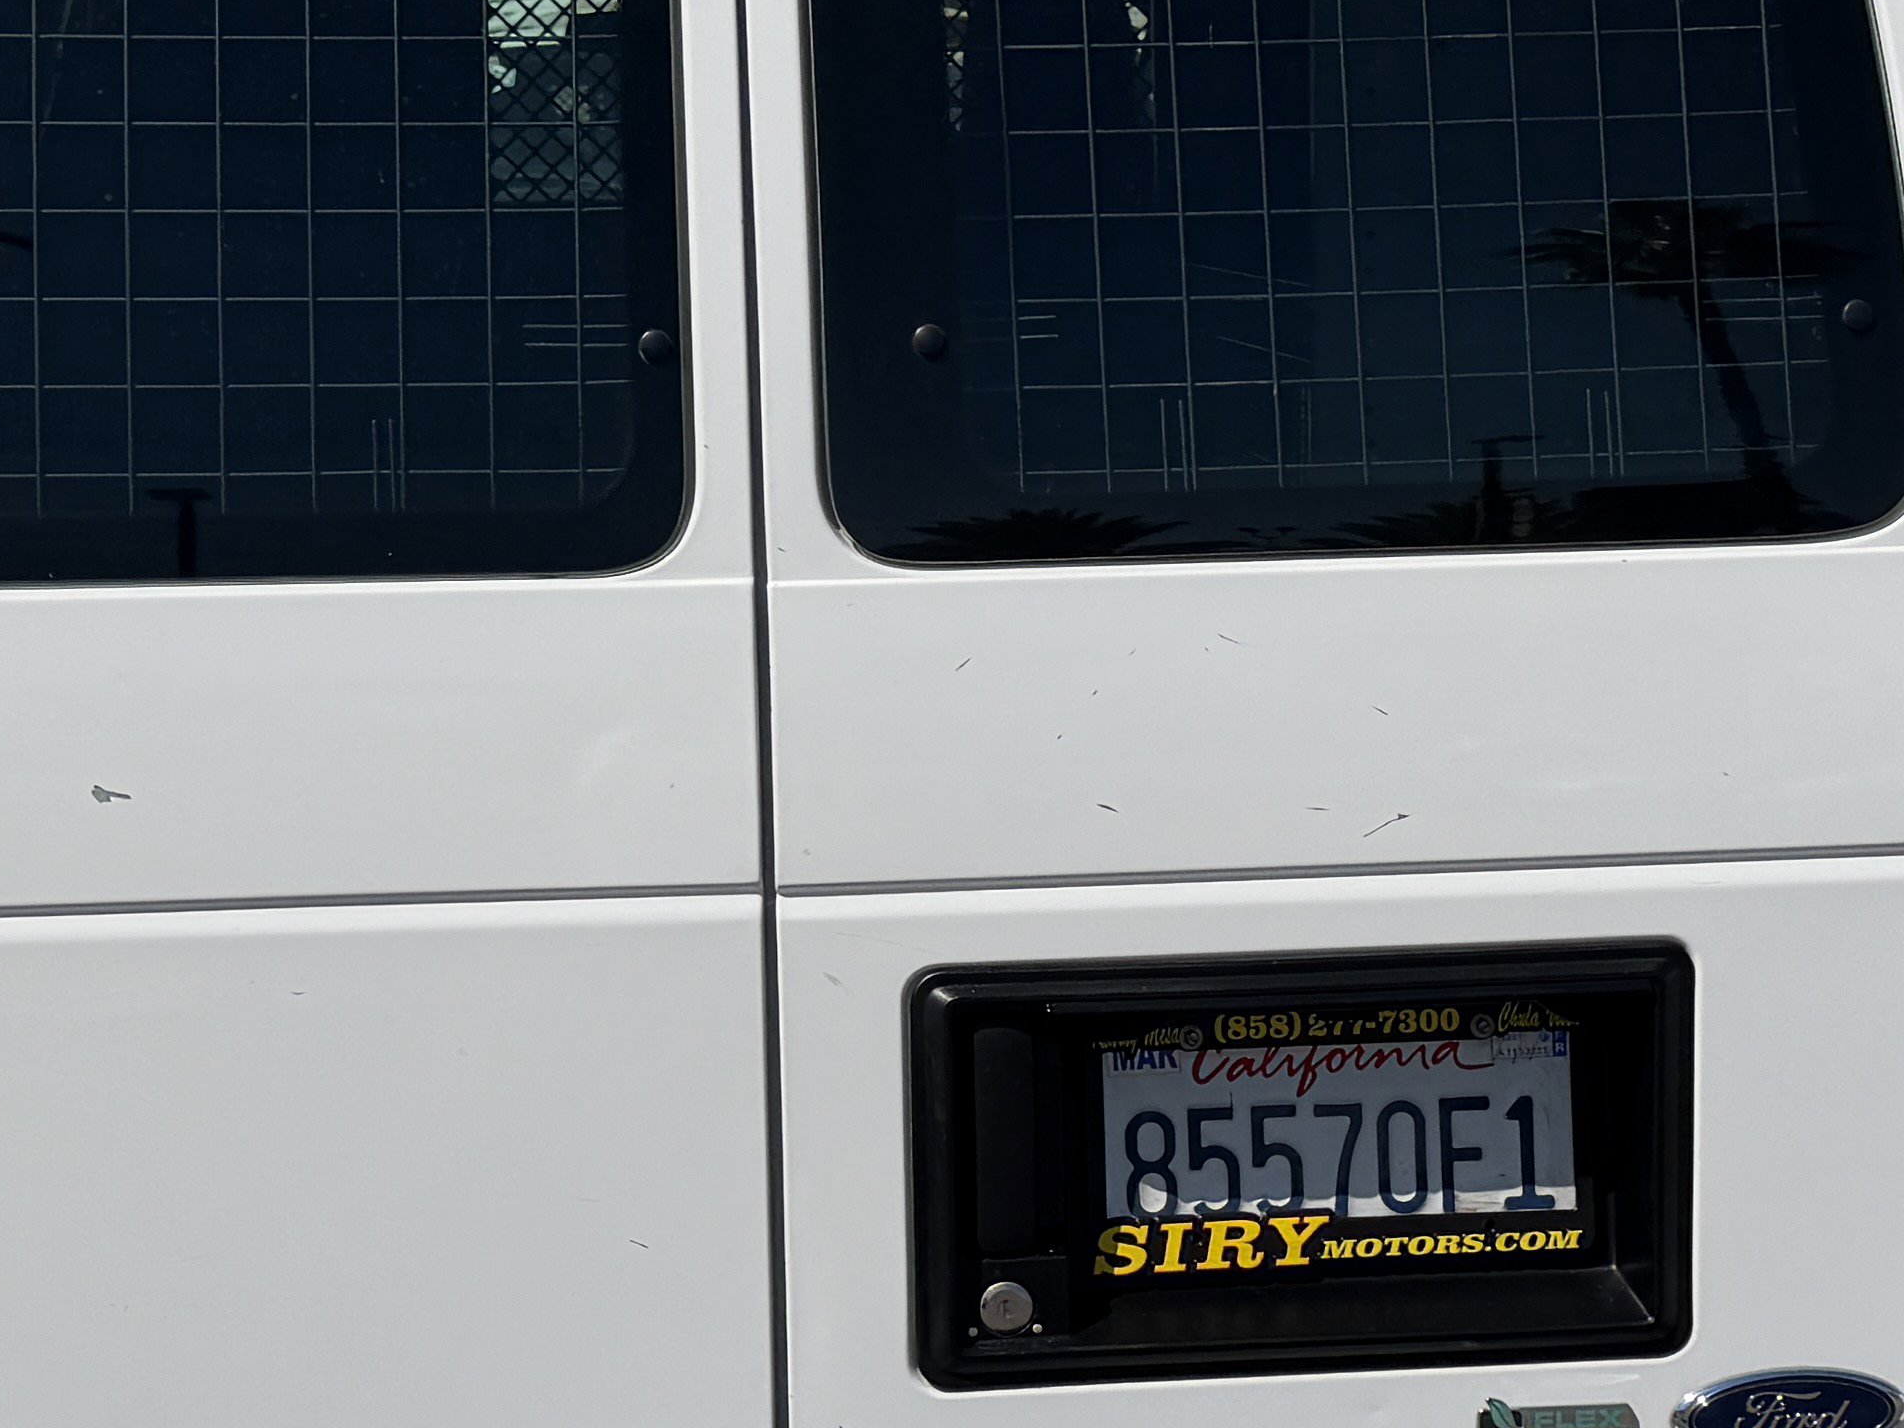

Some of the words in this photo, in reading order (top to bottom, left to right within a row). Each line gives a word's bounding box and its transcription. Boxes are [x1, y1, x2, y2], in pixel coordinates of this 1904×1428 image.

[1214, 1011, 1301, 1044] (858)
[1112, 1051, 1178, 1071] MAR
[1192, 1039, 1495, 1098] California
[1124, 1094, 1557, 1217] 85570F1
[1094, 1215, 1330, 1276] SIRY
[1321, 1229, 1583, 1261] MOTORS.COM
